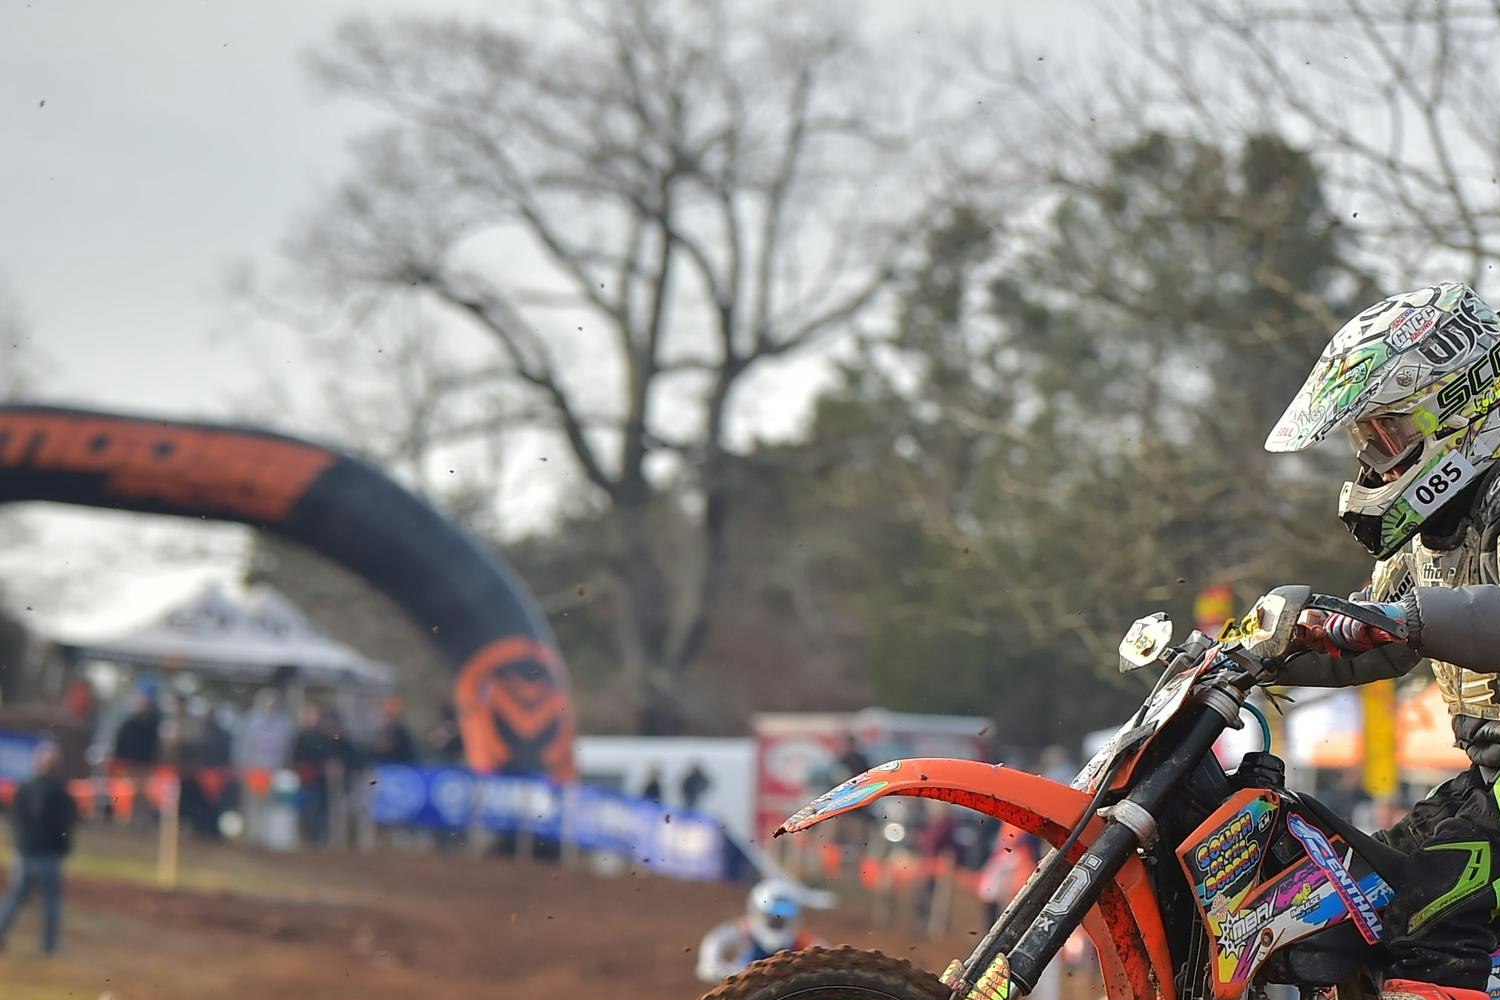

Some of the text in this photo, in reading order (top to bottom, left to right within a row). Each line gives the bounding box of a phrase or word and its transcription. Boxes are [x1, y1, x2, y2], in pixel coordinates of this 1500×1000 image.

[1392, 306, 1435, 348] GNCC
[1409, 320, 1433, 343] RACING
[1415, 461, 1463, 505] 085
